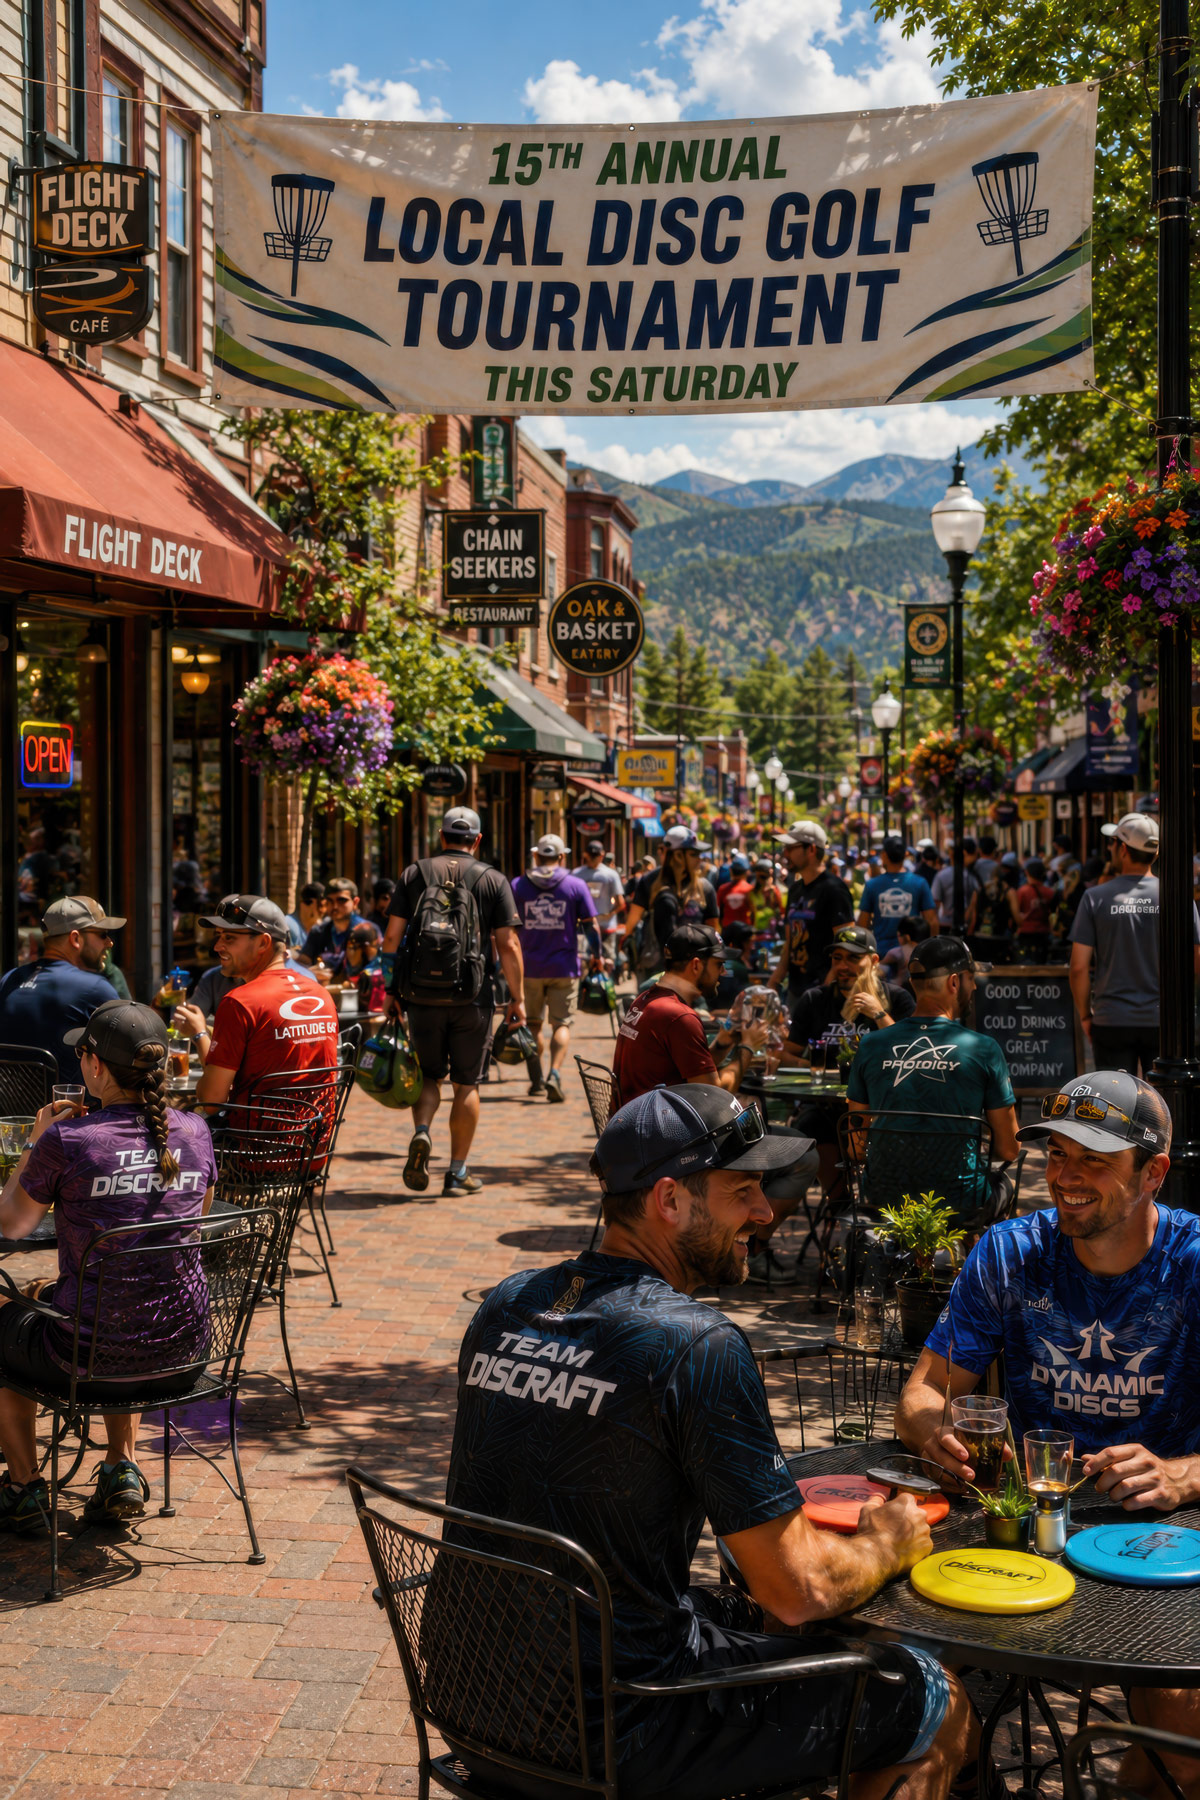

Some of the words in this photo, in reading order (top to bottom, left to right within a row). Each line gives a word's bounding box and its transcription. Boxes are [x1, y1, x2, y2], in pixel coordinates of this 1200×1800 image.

[488, 142, 584, 186] 15TH
[595, 135, 788, 186] ANNUAL
[40, 171, 140, 212] FLIGHT
[51, 211, 129, 248] DECK
[363, 196, 564, 266] LOCAL
[586, 195, 745, 266] DISC
[765, 183, 936, 262] GOLF
[69, 316, 110, 334] CAFÉ
[397, 268, 900, 352] TOURNAMENT
[484, 365, 573, 402] THIS
[586, 361, 799, 403] SATURDAY
[63, 513, 141, 569] FLIGHT
[150, 536, 203, 584] DECK
[463, 529, 524, 551] CHAIN
[450, 556, 537, 579] SEEKERS
[453, 606, 533, 622] RESTAURANT
[567, 599, 611, 618] OAK
[613, 601, 626, 617] &
[556, 621, 636, 641] BASKET
[24, 734, 71, 773] OPEN
[985, 983, 1021, 999] GOOD
[1026, 984, 1061, 999] FOOD
[983, 1015, 1017, 1030] COLD
[1021, 1015, 1066, 1030] DRINKS
[1005, 1039, 1049, 1054] GREAT
[1008, 1062, 1063, 1077] OMPANY
[496, 1331, 594, 1369] TEAM
[465, 1352, 618, 1417] DISCRAFT
[1031, 1361, 1165, 1396] DYNAMIC
[1053, 1390, 1141, 1418] DISCS
